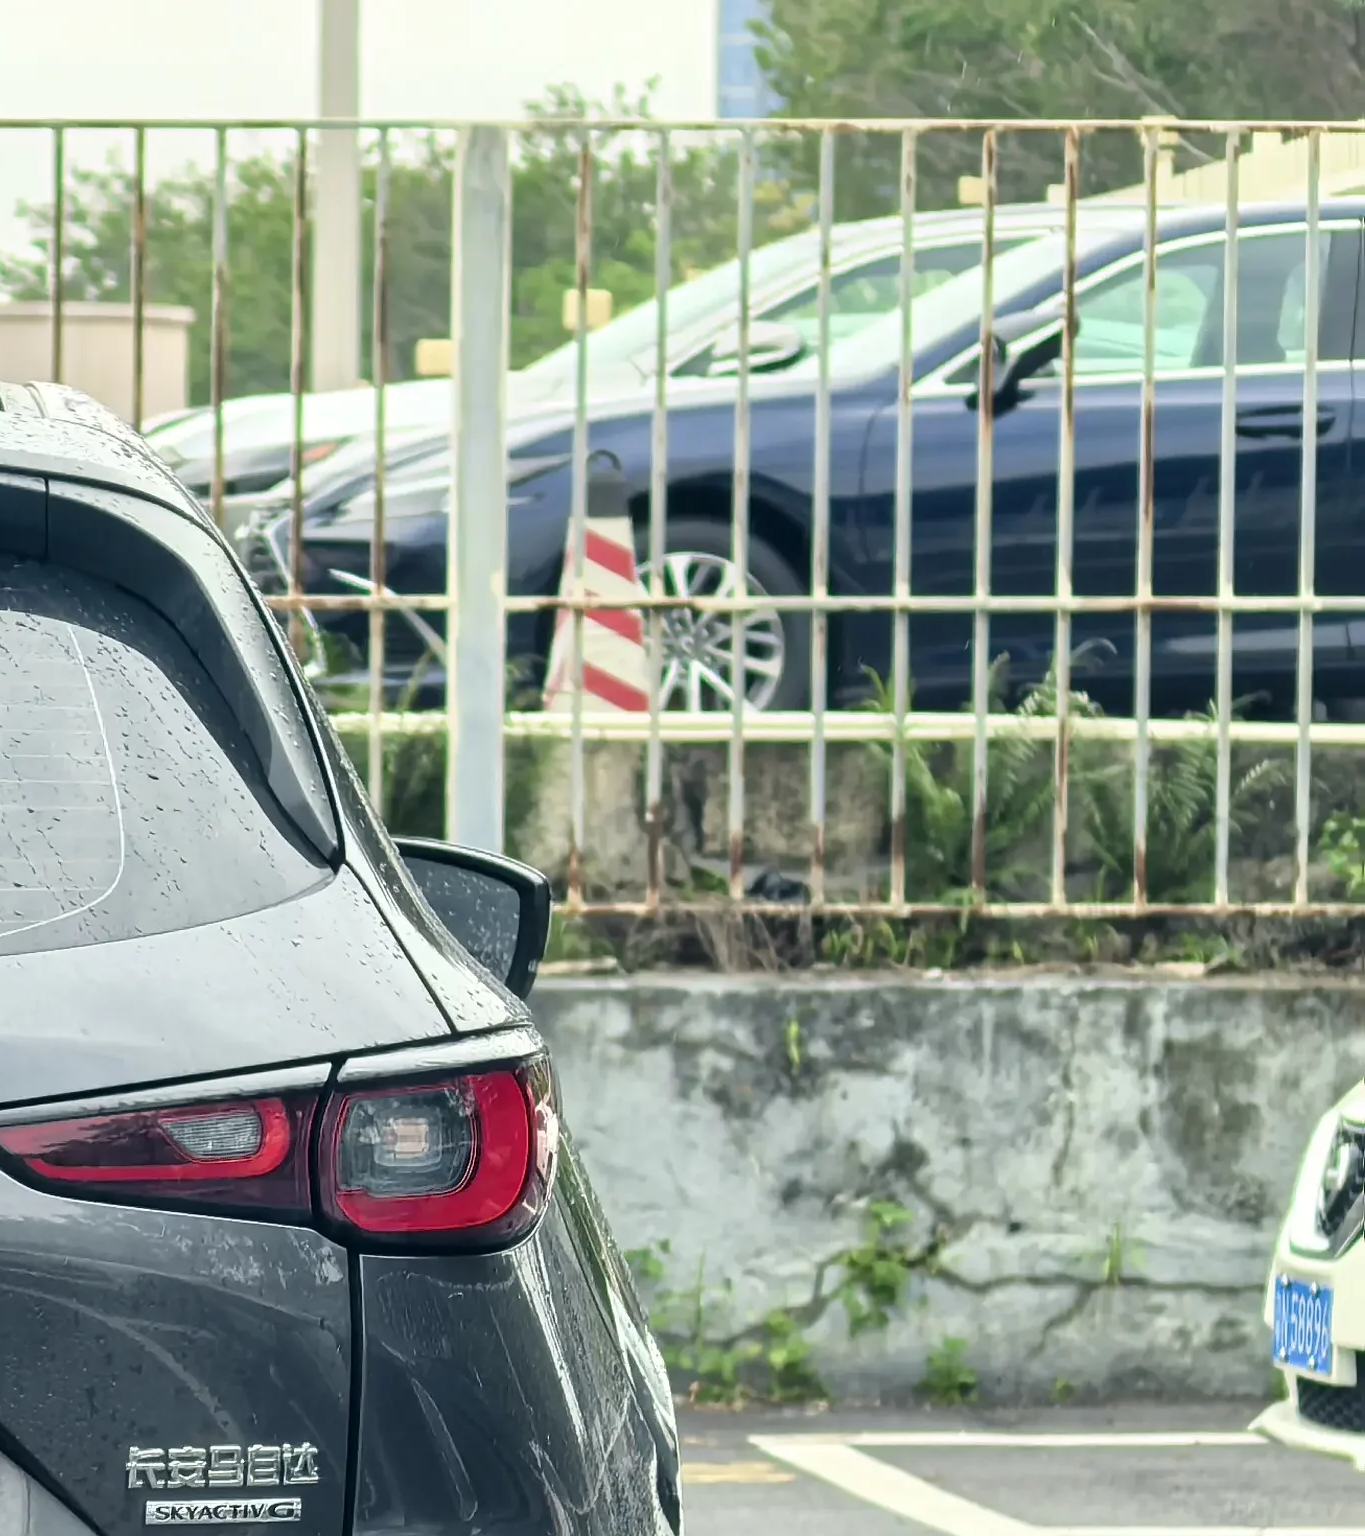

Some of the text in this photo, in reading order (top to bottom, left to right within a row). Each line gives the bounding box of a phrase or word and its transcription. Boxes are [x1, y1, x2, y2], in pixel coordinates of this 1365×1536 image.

[126, 1442, 319, 1489] 长安马自达
